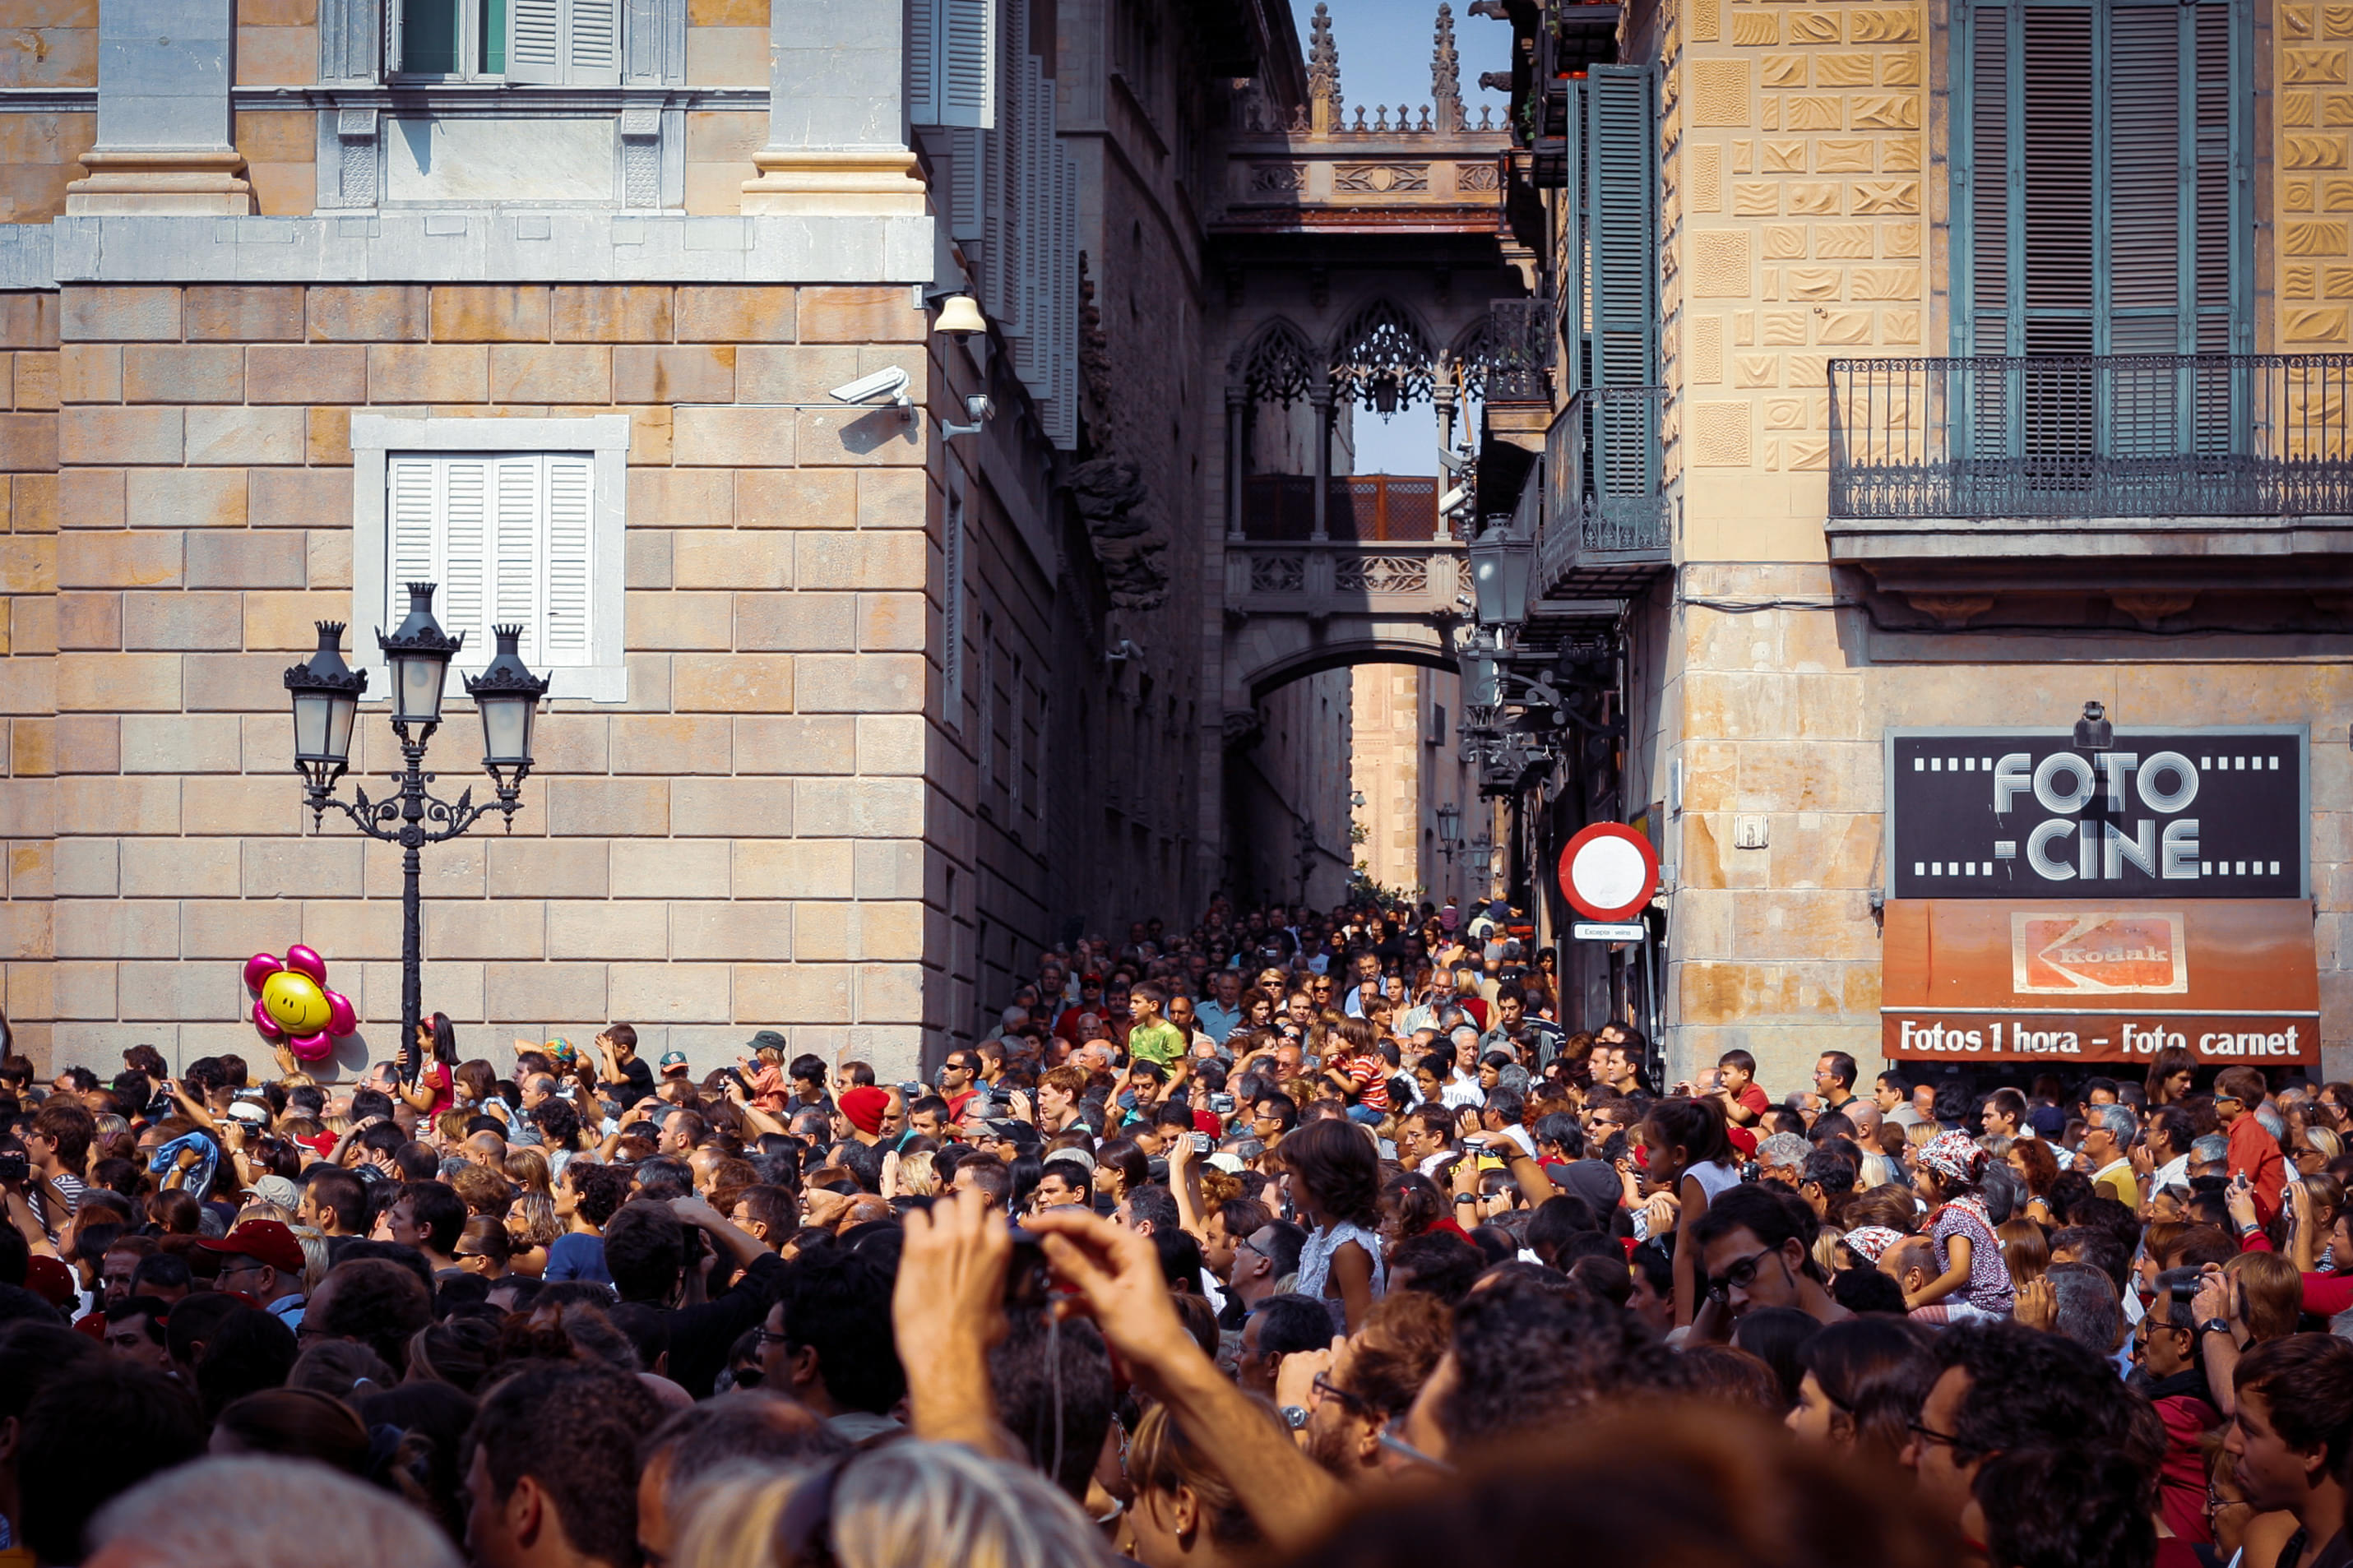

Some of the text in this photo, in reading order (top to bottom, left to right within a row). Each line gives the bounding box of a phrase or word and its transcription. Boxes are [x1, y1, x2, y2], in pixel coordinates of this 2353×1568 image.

[1994, 751, 2199, 814] FOTO
[2059, 946, 2169, 964] Kodak
[1901, 1020, 1982, 1052] Fotos
[1989, 1022, 2002, 1052] 1
[2013, 1022, 2081, 1052] hora
[2123, 1023, 2186, 1053] Foto
[2199, 1025, 2300, 1056] carnet
